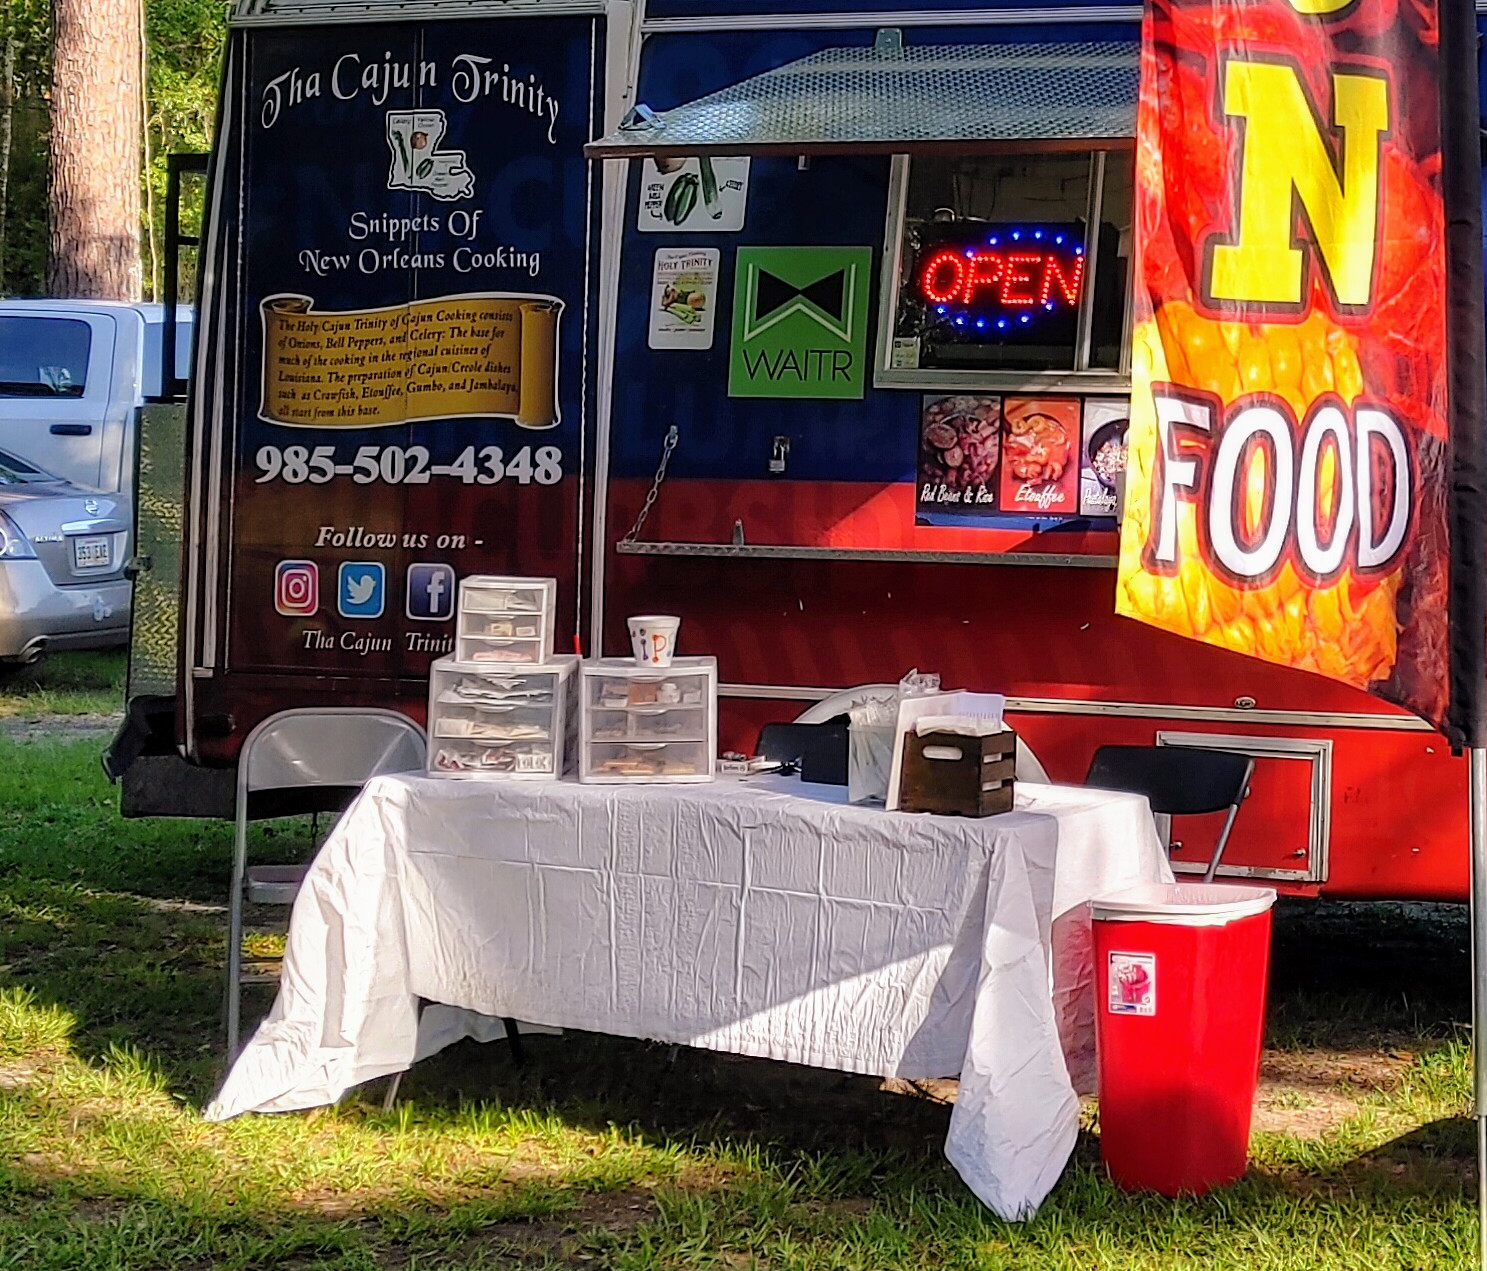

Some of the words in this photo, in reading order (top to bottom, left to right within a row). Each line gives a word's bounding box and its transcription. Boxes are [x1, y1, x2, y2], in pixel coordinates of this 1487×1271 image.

[261, 67, 320, 128] Tha
[331, 50, 437, 106] Cajun
[452, 54, 559, 144] Trinity
[349, 211, 440, 240] Snippets
[448, 209, 483, 239] Of
[298, 249, 350, 276] New
[358, 247, 445, 274] Orleans
[453, 246, 541, 277] Cooking
[924, 254, 1084, 305] OPEN
[322, 320, 350, 335] Cajun
[354, 316, 387, 331] Trinity
[390, 314, 401, 330] of
[437, 309, 477, 324] Cooking
[326, 336, 345, 349] Bell
[348, 335, 386, 350] Peppers,
[389, 331, 407, 345] and
[449, 326, 468, 339] The
[303, 354, 313, 369] of
[314, 354, 328, 366] the
[329, 353, 365, 368] cooking
[368, 352, 379, 364] in
[382, 350, 396, 362] the
[440, 344, 479, 357] cuisines
[480, 343, 493, 358] of
[742, 349, 854, 382] WAITR
[327, 371, 344, 384] The
[347, 368, 402, 386] preparation
[484, 361, 511, 374] dishes
[301, 391, 311, 401] as
[313, 389, 359, 403] Crawfish,
[406, 379, 446, 394] Gumbo,
[448, 378, 467, 391] and
[314, 406, 335, 419] from
[337, 404, 355, 417] this
[358, 404, 380, 417] base.
[254, 444, 563, 485] 985-502-4348
[920, 483, 936, 504] Red
[963, 485, 973, 504] &
[1014, 484, 1066, 509] Etouffee
[1155, 397, 1409, 577] FOOD
[315, 526, 397, 549] Follow
[402, 533, 428, 548] us
[436, 534, 466, 549] on
[303, 629, 334, 650] Tha
[340, 631, 391, 656] Cajun
[405, 632, 456, 654] Trinit
